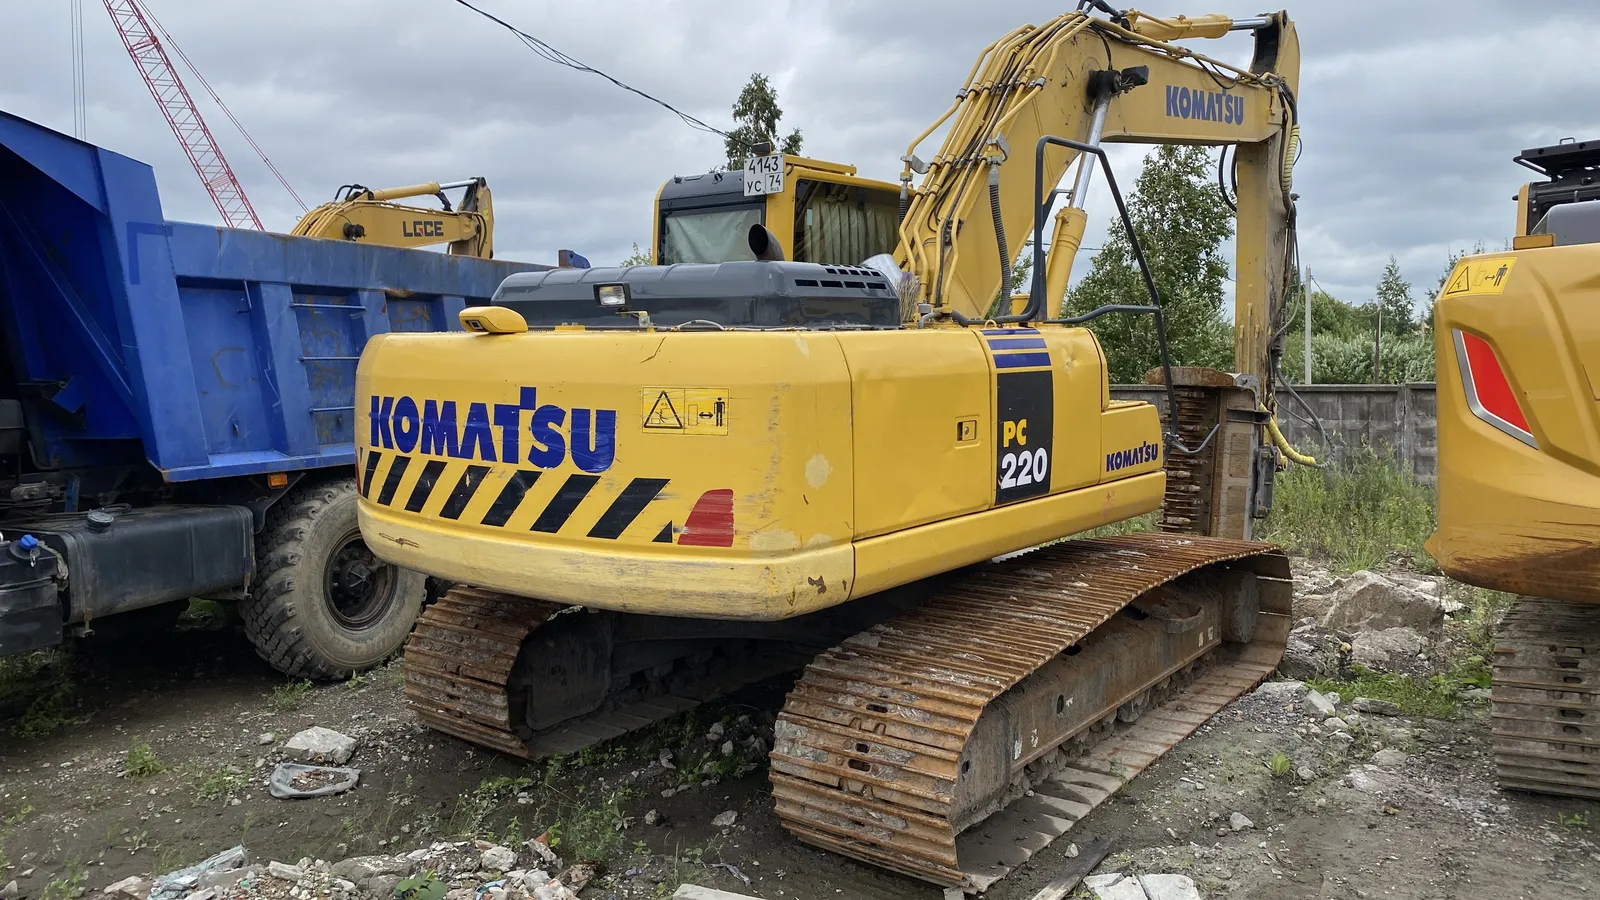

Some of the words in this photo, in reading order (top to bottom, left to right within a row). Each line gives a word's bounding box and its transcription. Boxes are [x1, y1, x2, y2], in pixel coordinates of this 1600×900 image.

[1166, 85, 1244, 126] KOMATSU
[748, 156, 779, 175] 4143
[769, 174, 781, 187] 74
[402, 220, 444, 238] LGCE
[368, 386, 617, 474] KOMATSU
[1003, 418, 1027, 448] PC
[1001, 447, 1048, 490] 220
[1105, 440, 1159, 473] KOMATSU
